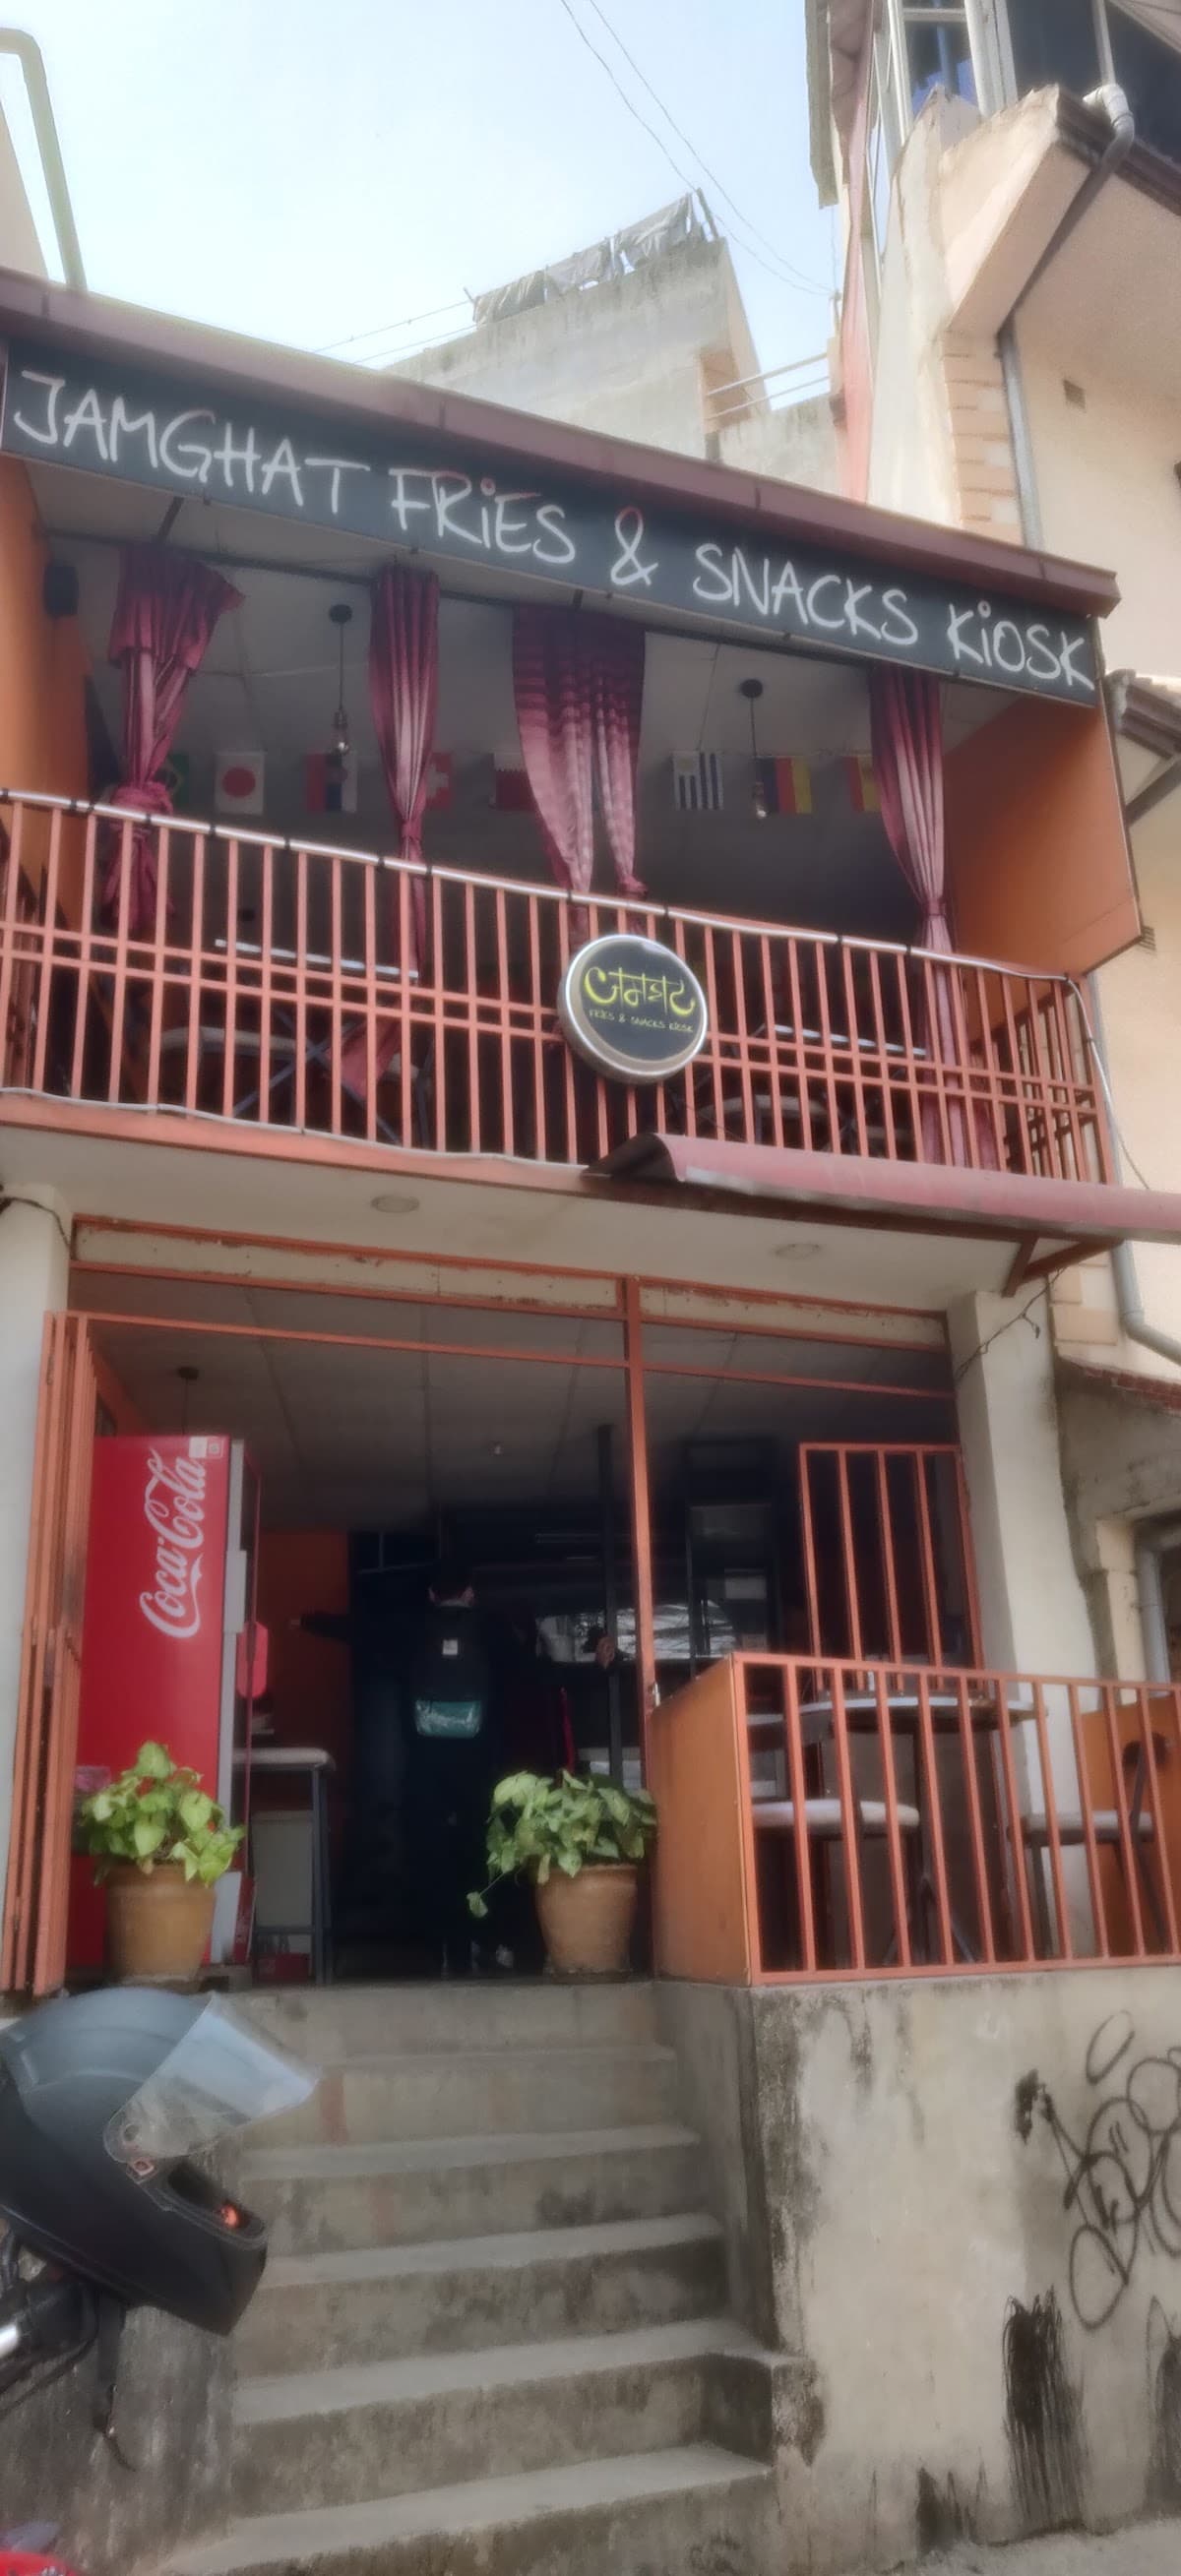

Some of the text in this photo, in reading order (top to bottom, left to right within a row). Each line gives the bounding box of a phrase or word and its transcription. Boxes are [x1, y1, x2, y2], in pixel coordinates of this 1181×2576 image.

[14, 369, 371, 515] JAMGHAT
[609, 506, 659, 587] &
[692, 542, 919, 645] SNACKS
[618, 1013, 626, 1024] &
[139, 1446, 207, 1638] Coca-Cola
